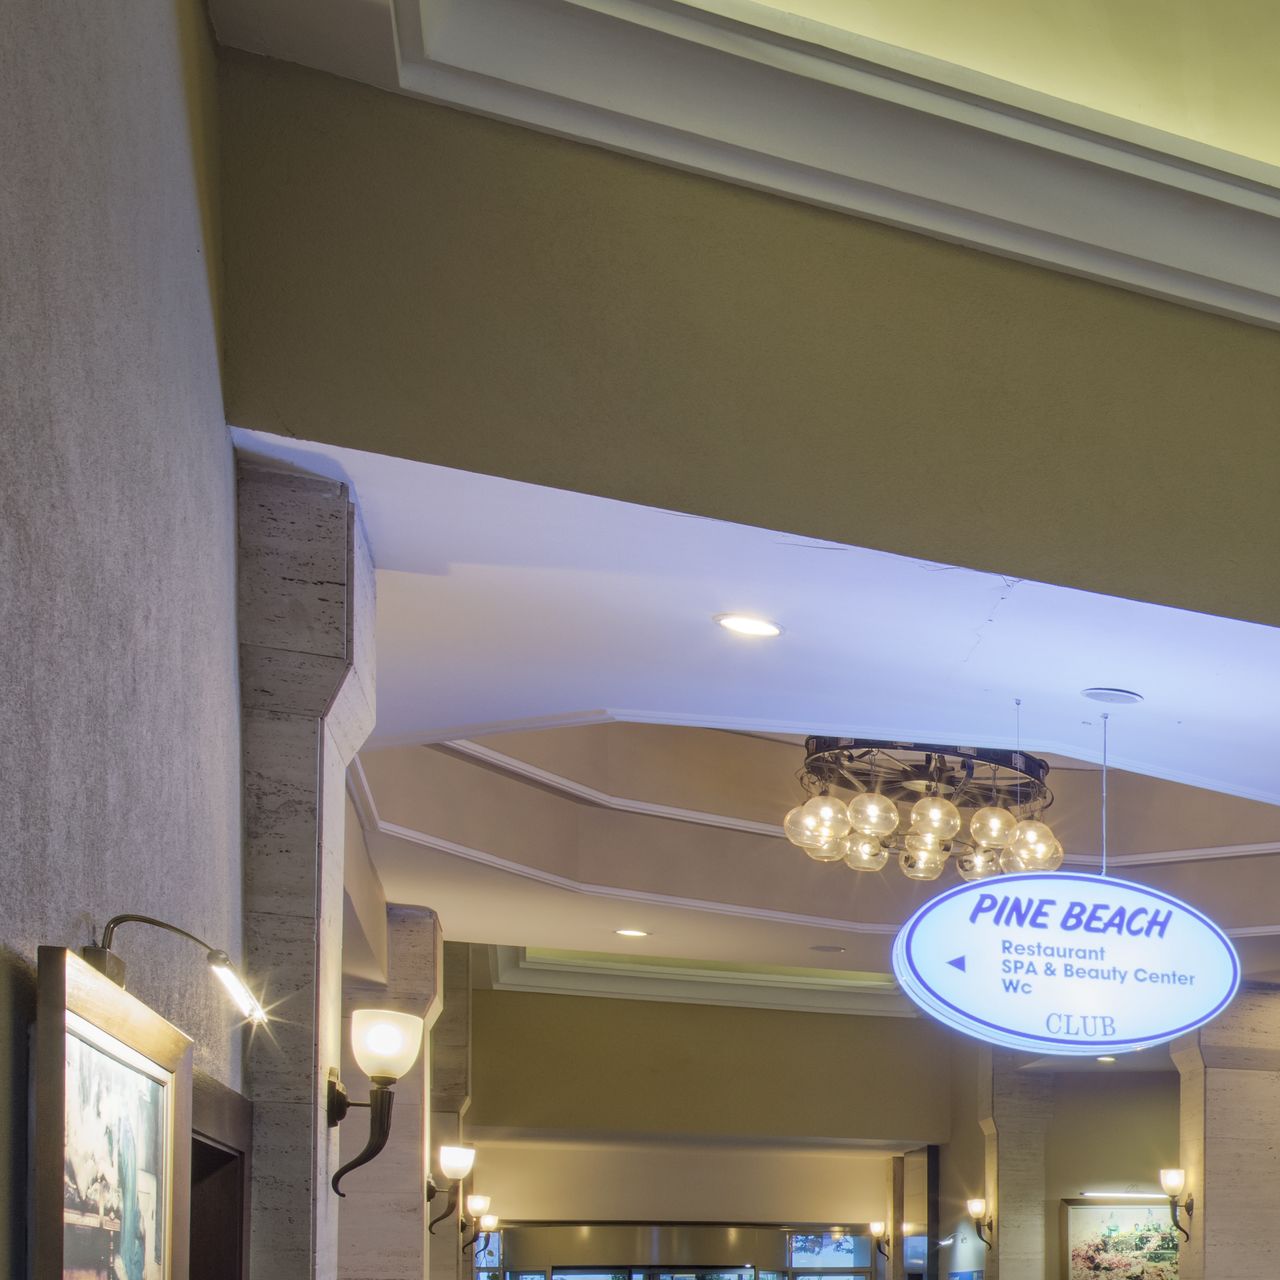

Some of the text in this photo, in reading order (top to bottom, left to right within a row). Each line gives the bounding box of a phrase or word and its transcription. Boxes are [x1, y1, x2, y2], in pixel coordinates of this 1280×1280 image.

[969, 893, 1172, 939] PINE BEACH
[1002, 940, 1105, 961] Restaurant
[1002, 960, 1196, 986] SPA & Beauty Center
[1002, 979, 1033, 995] Wc
[1045, 1013, 1117, 1038] CLUB
